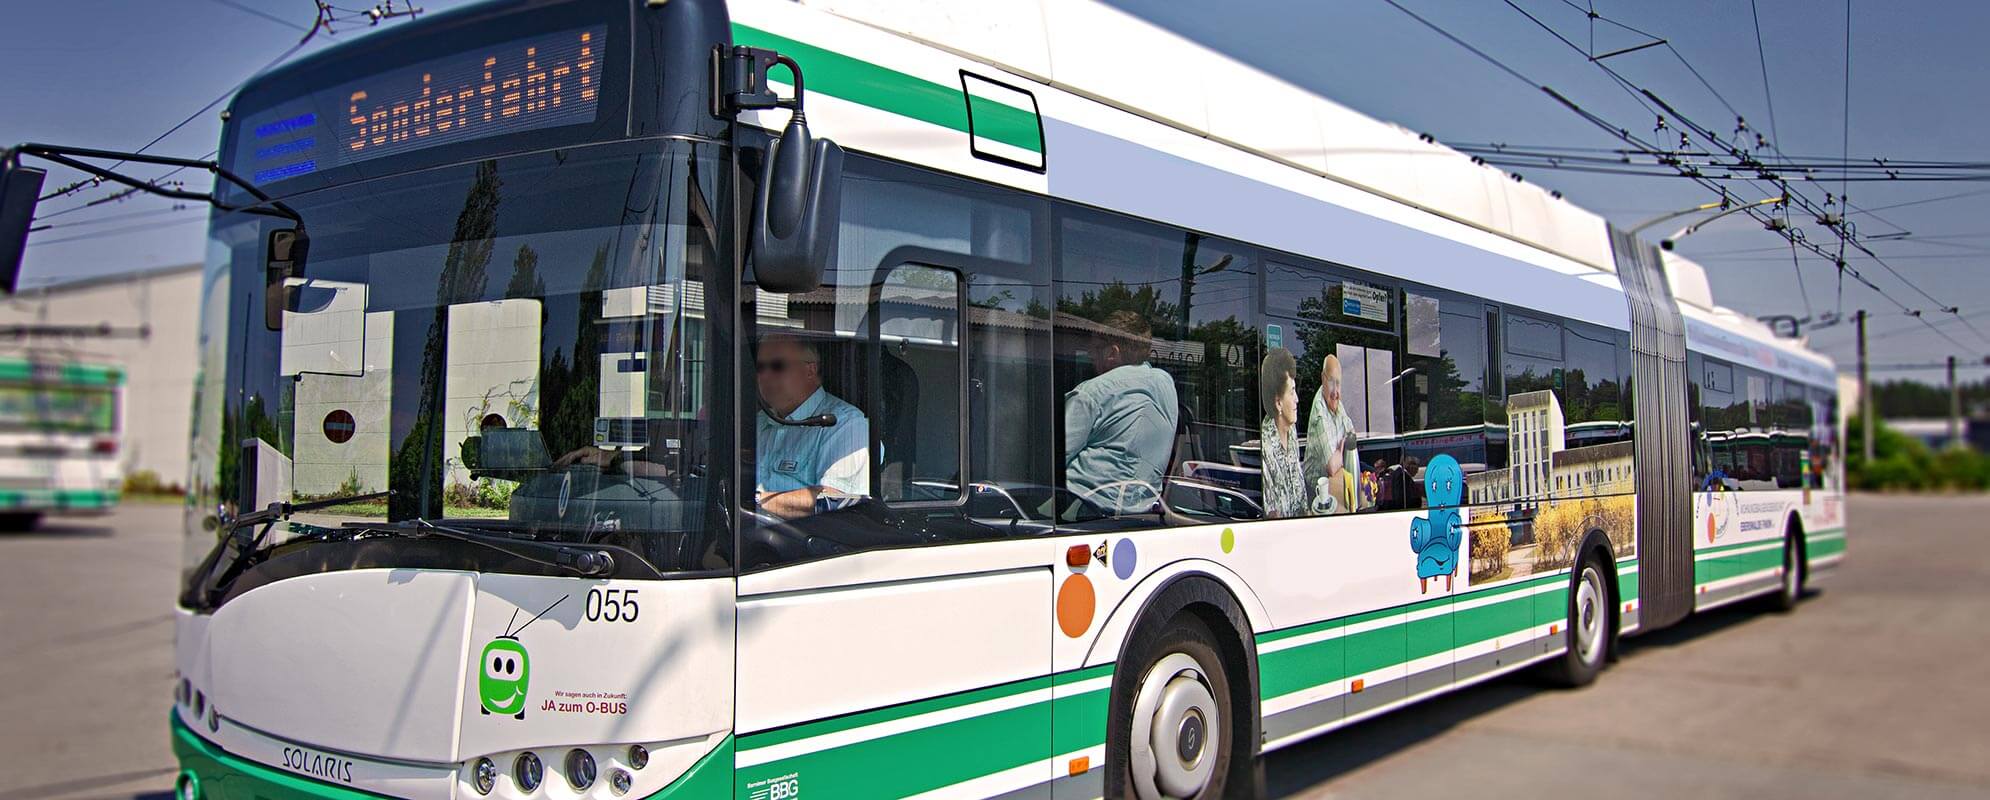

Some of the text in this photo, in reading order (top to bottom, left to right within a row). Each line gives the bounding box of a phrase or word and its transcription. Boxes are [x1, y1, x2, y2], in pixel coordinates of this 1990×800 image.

[350, 32, 595, 150] Sonderfahrt
[586, 588, 639, 623] 055
[541, 700, 627, 714] JA zum O-BUS
[565, 691, 581, 699] sagen
[282, 747, 353, 783] SOLARIS
[770, 779, 799, 800] BBG
